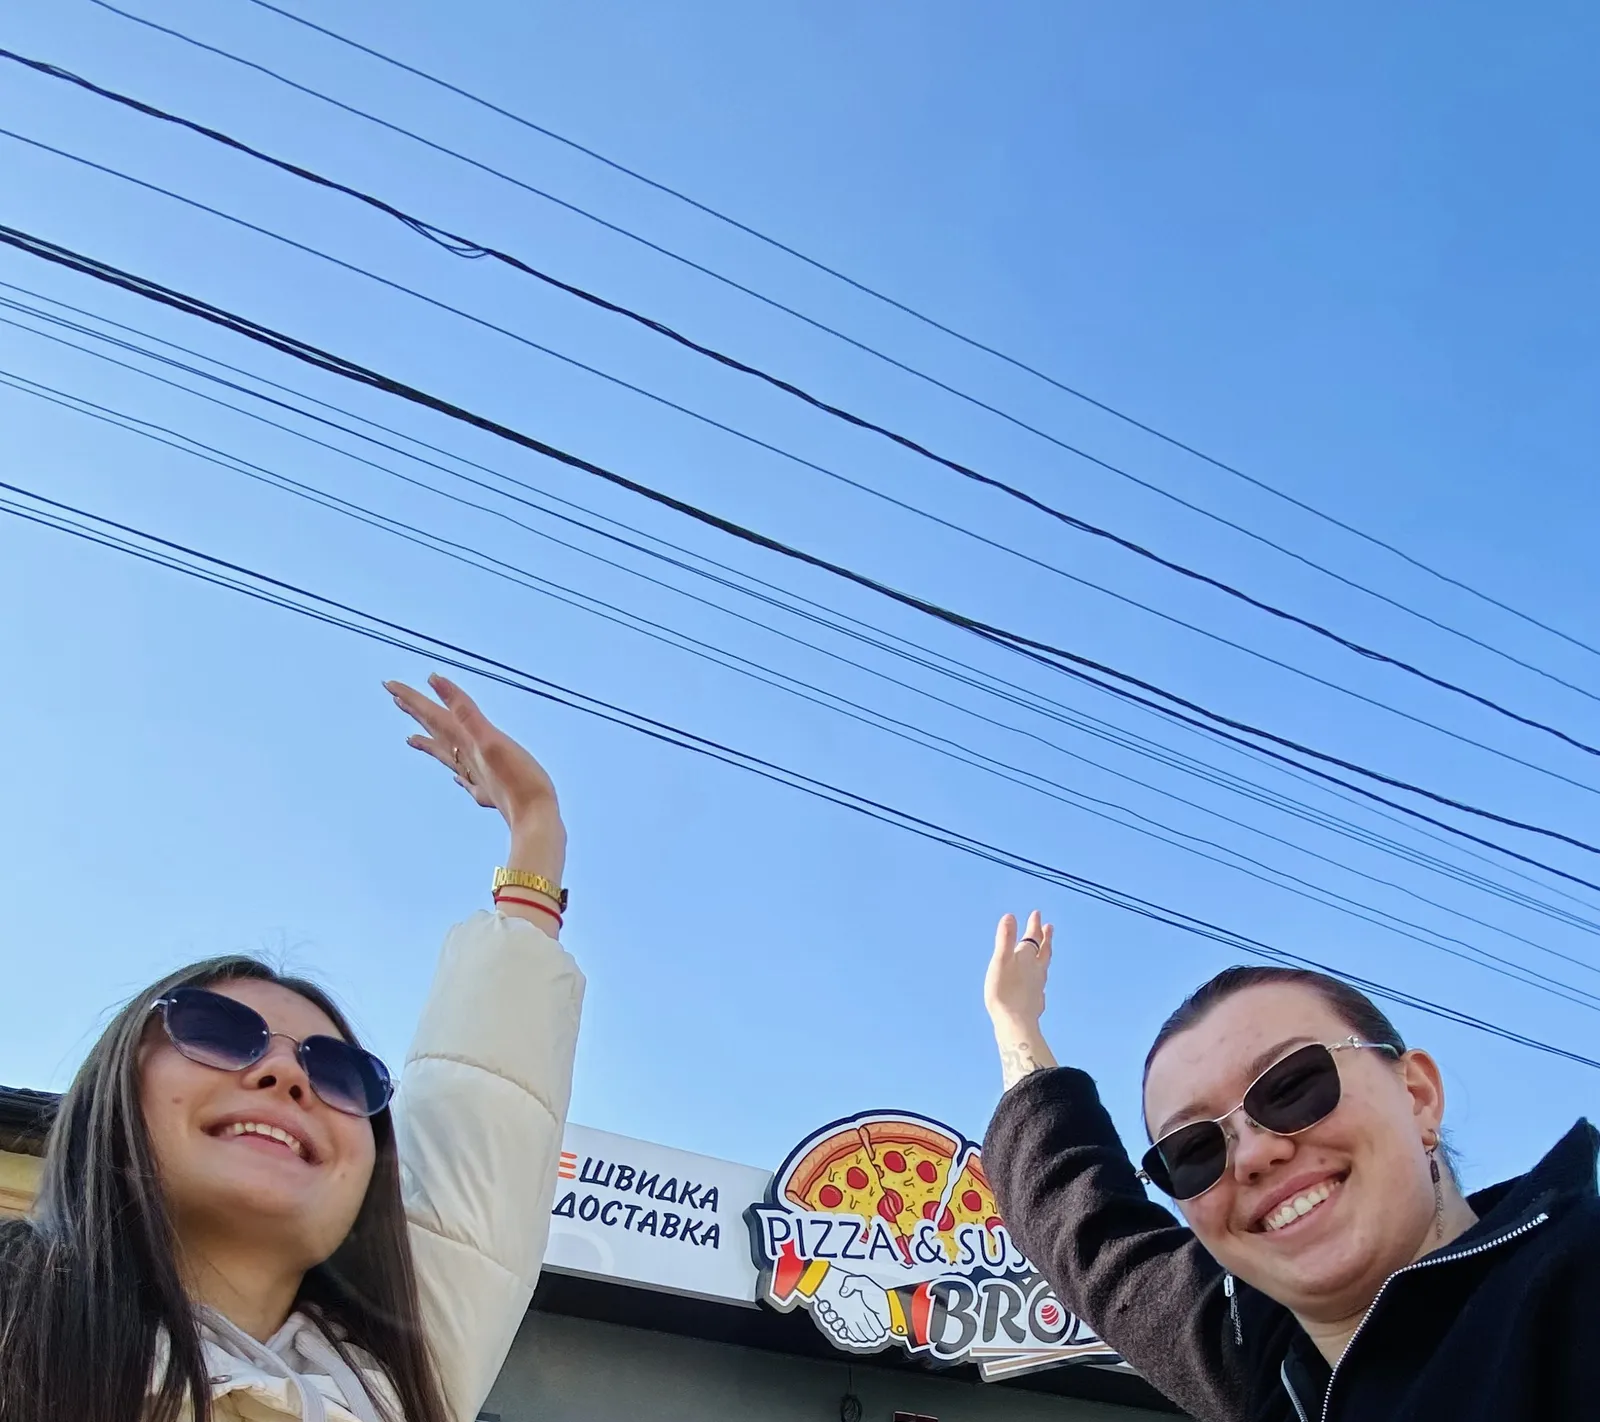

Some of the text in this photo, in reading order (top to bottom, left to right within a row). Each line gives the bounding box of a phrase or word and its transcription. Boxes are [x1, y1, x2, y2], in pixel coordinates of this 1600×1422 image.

[578, 1156, 719, 1213] ШВИДКА
[551, 1191, 720, 1250] ДОСТАВКА
[766, 1216, 1027, 1268] PIZZA & SUS
